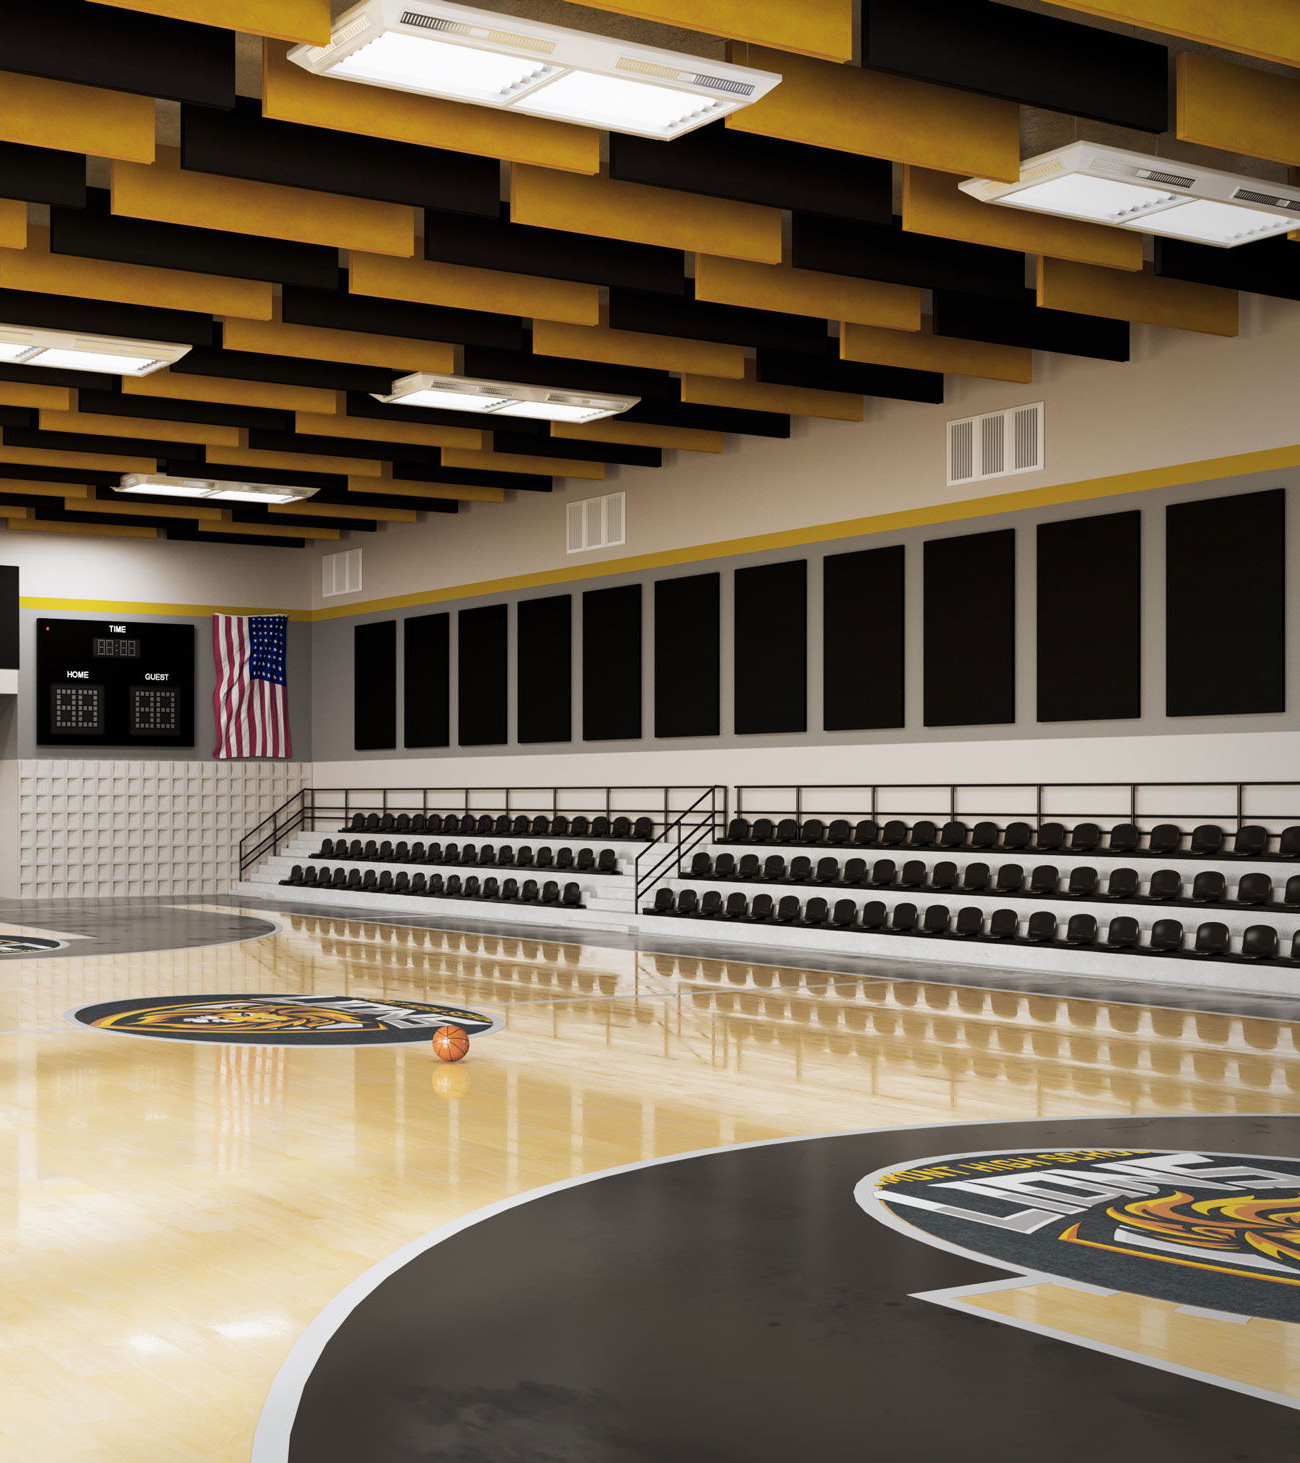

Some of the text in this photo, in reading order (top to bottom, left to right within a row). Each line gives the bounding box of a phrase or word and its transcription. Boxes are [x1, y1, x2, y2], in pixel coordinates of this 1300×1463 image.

[109, 625, 126, 633] TIME
[66, 670, 89, 679] HOME
[144, 673, 169, 681] GUEST
[873, 1149, 1153, 1187] MONT HIGH SCHO
[873, 1153, 1300, 1234] LIONS
